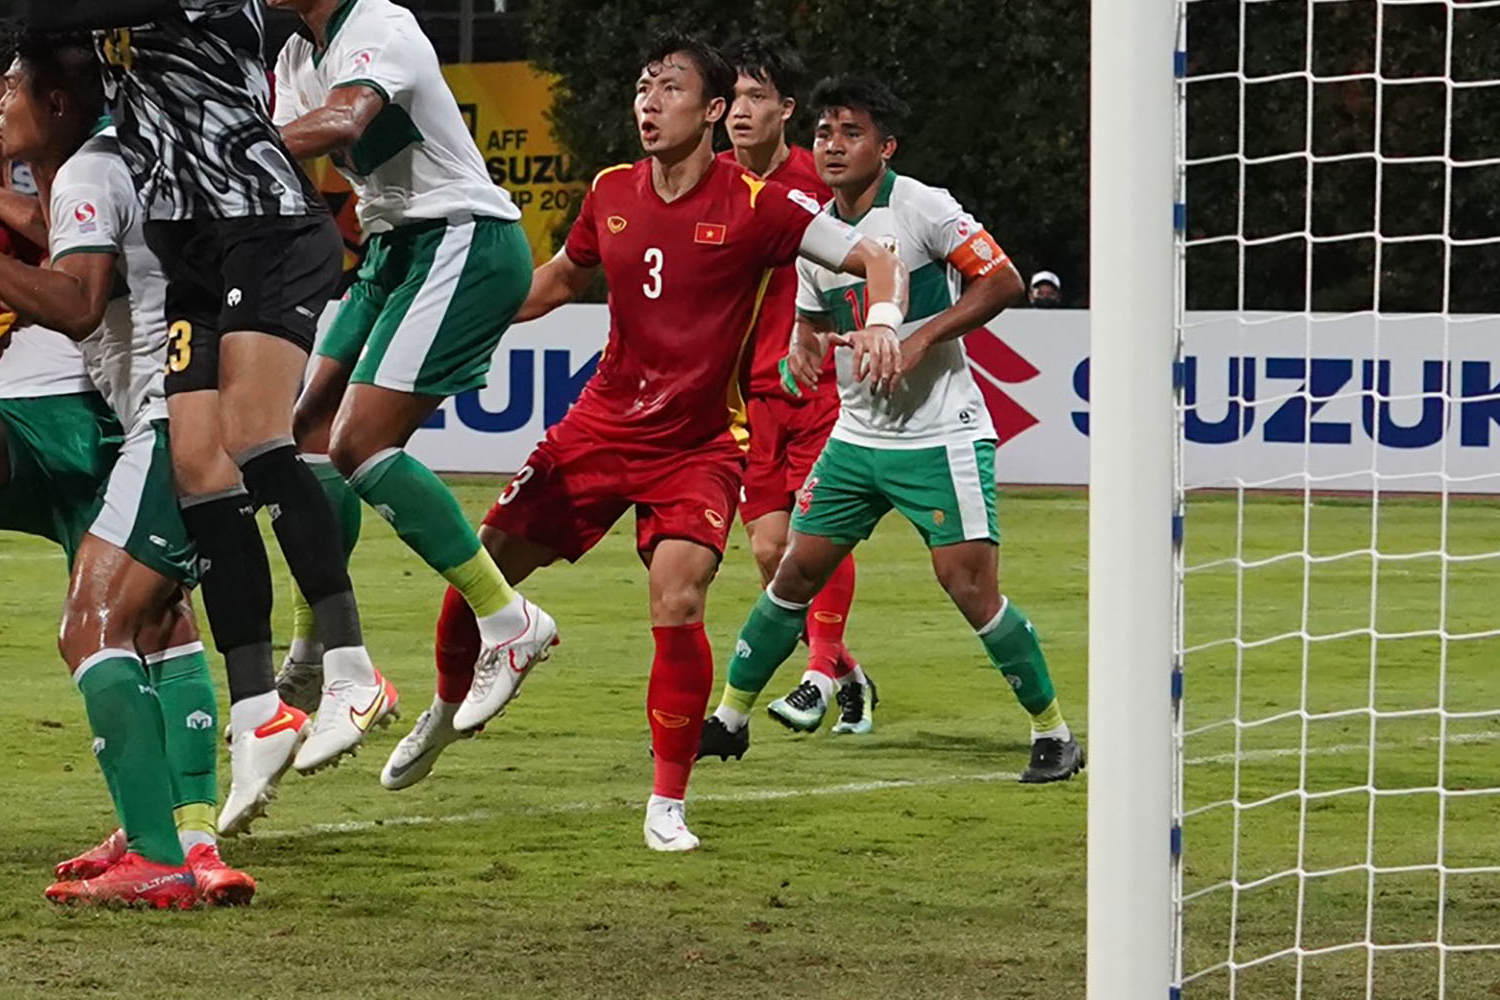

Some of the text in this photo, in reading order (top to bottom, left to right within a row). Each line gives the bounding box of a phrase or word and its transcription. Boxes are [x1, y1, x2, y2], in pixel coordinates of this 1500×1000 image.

[486, 129, 527, 151] AFF
[642, 248, 663, 299] 3
[165, 320, 192, 375] 3
[498, 465, 534, 505] 3
